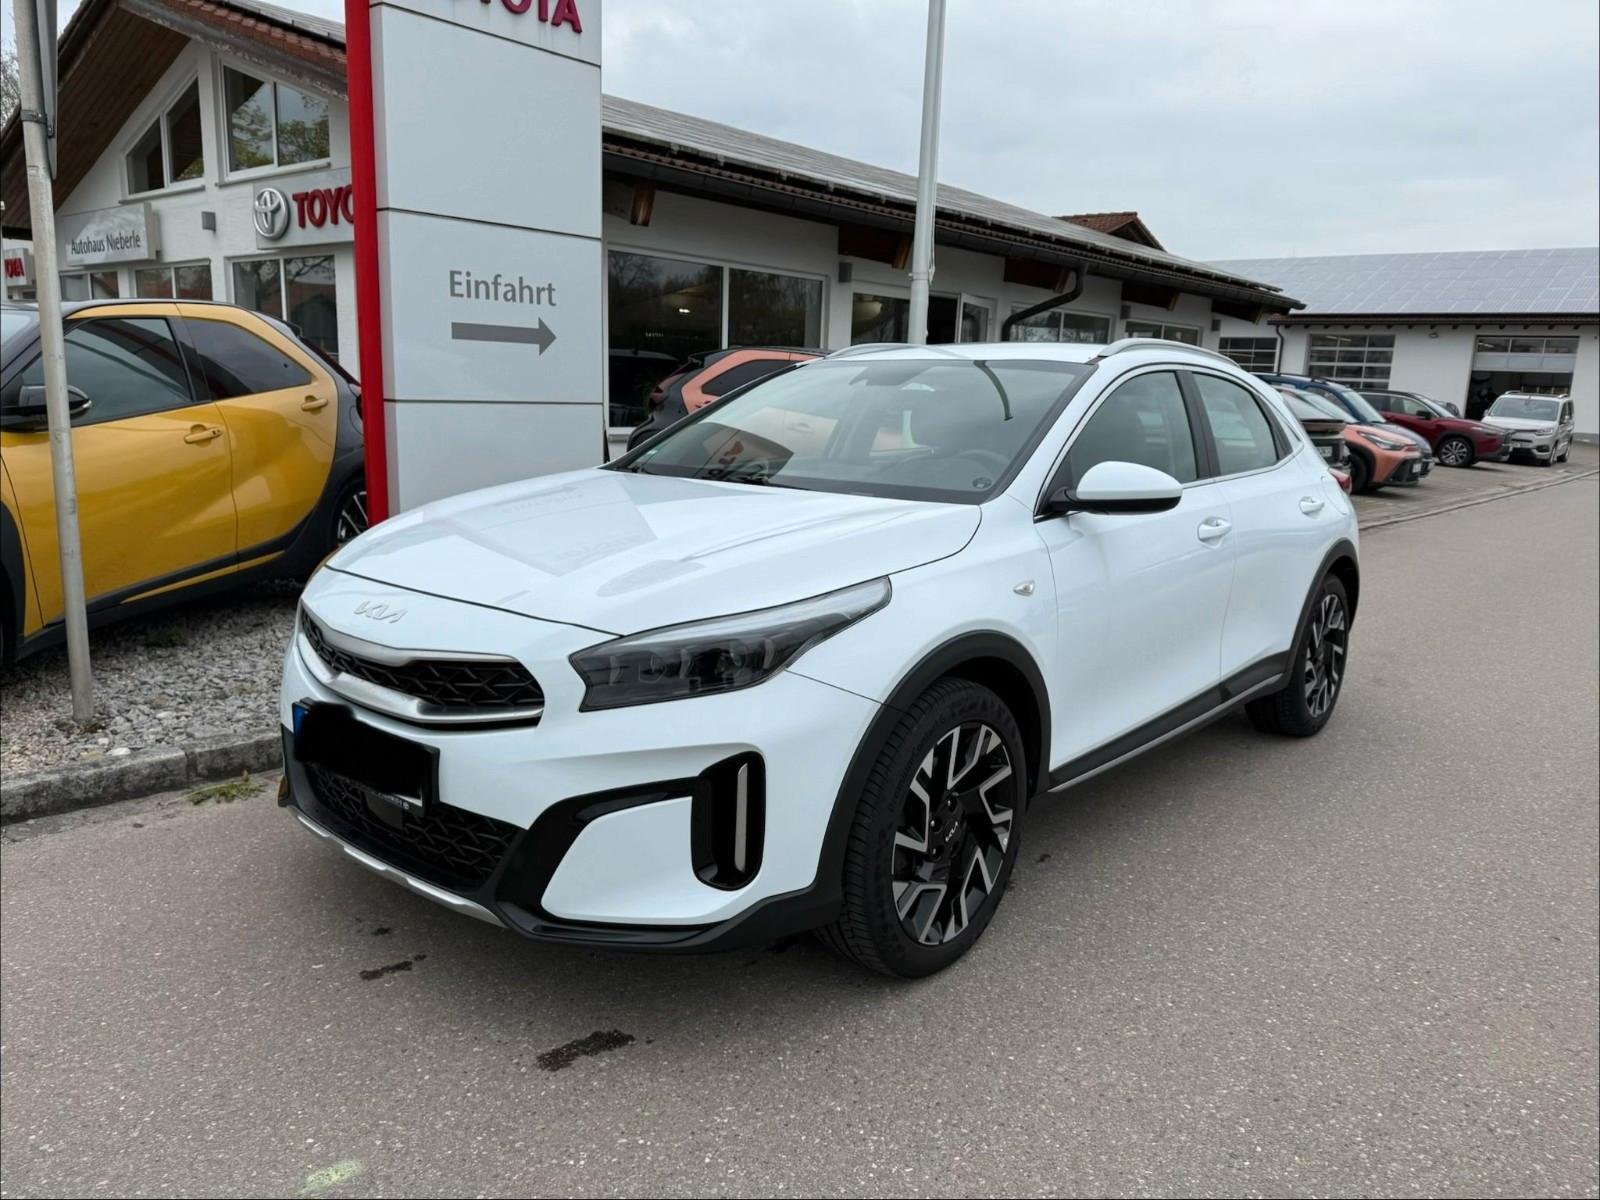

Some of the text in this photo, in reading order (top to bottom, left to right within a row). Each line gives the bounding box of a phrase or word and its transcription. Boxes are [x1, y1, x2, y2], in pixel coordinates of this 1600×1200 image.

[71, 230, 141, 254] Autohaus Nieberle
[449, 269, 557, 307] Einfahrt
[353, 599, 408, 624] KIA
